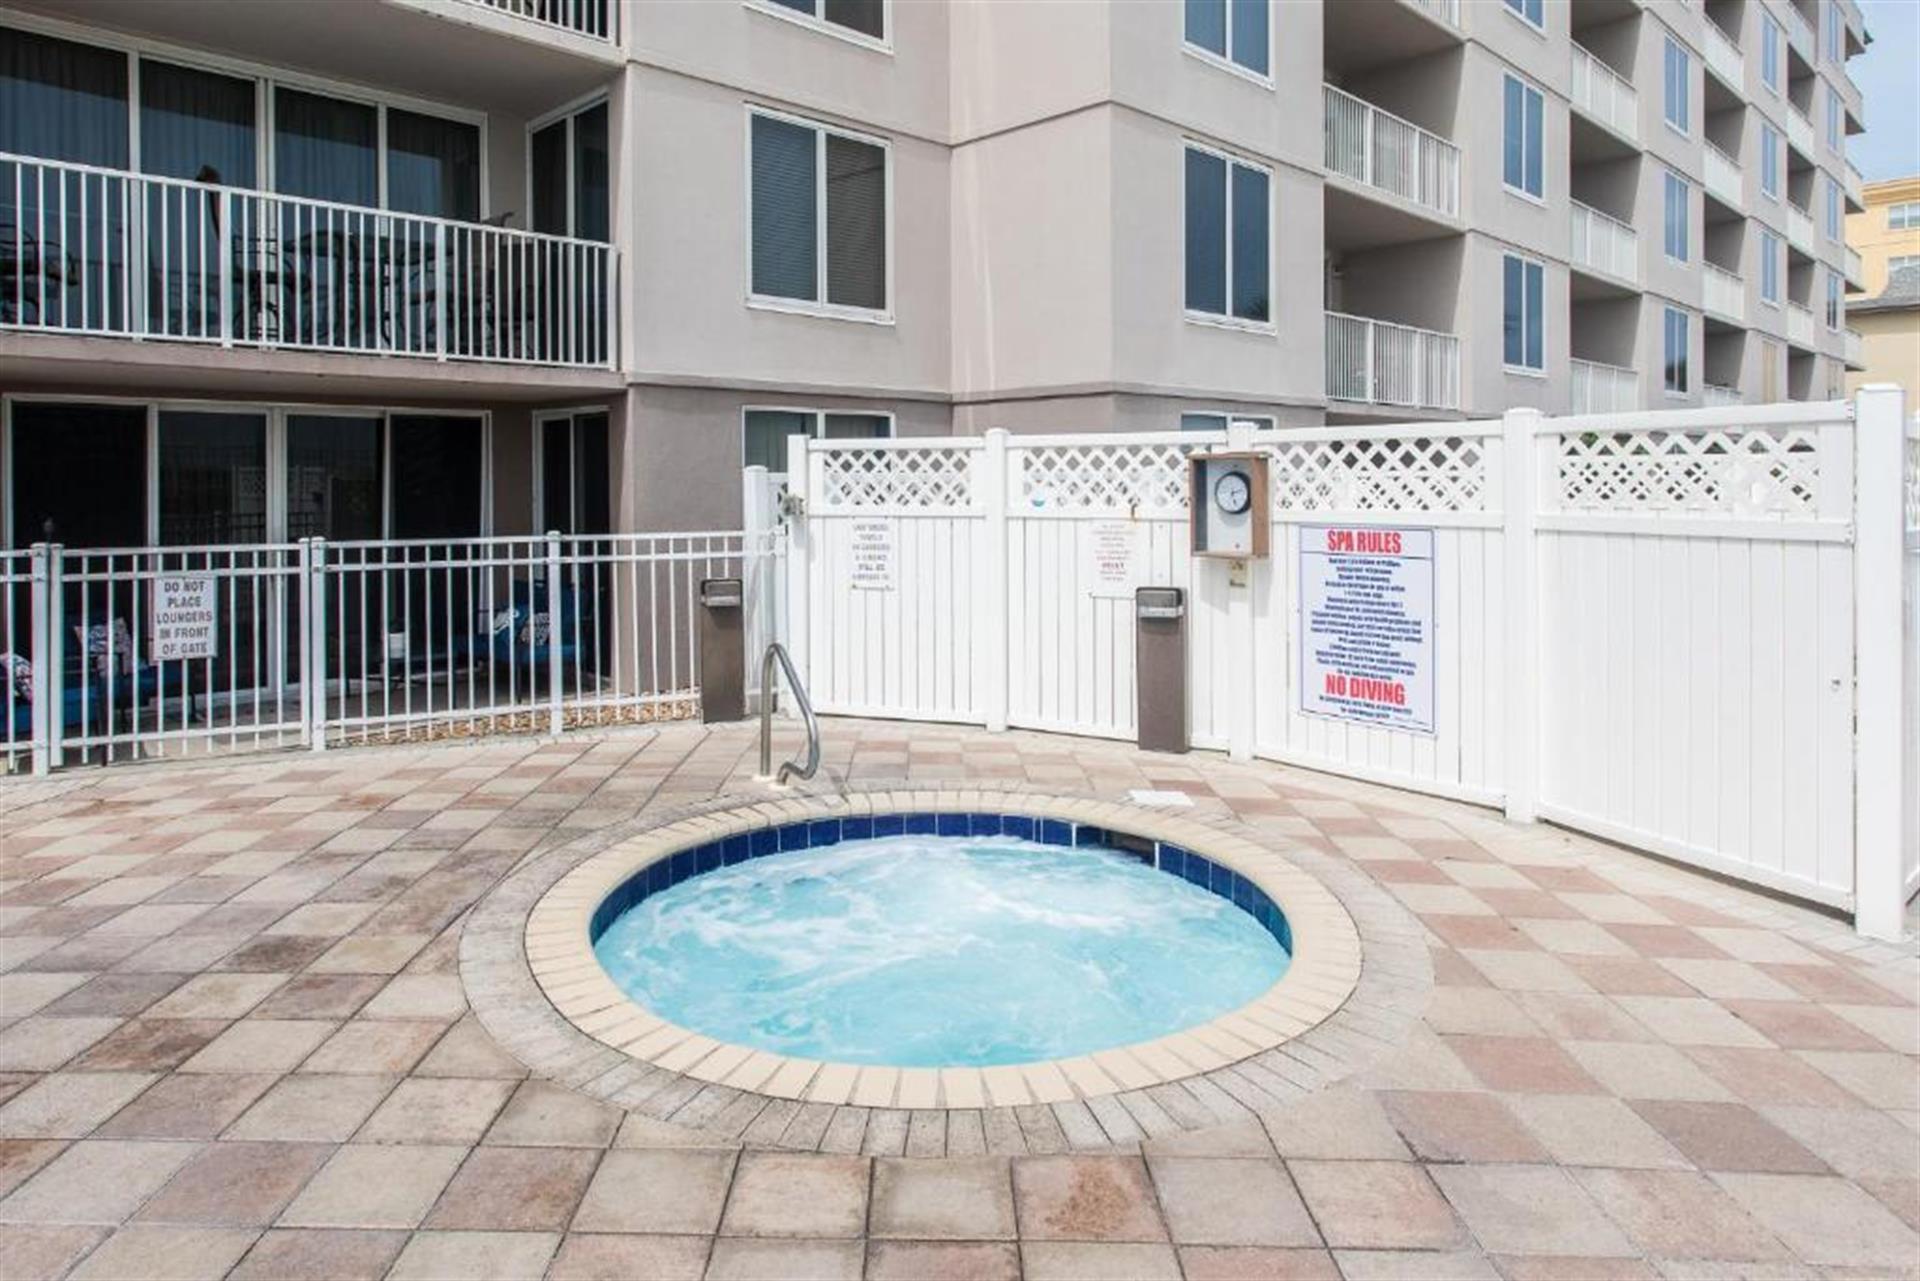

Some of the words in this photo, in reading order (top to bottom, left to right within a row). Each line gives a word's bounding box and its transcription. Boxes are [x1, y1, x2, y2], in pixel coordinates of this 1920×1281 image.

[1327, 530, 1354, 552] SPA
[1357, 531, 1402, 554] RULES
[164, 582, 179, 592] DO
[183, 581, 205, 592] NOT
[168, 596, 201, 608] PLACE
[156, 611, 212, 624] LOUNGERS
[160, 628, 170, 639] IN
[175, 627, 208, 638] FRONT
[162, 644, 176, 655] OF
[181, 642, 207, 654] GATE
[1326, 674, 1346, 696] NO
[1350, 677, 1405, 706] DIVING
